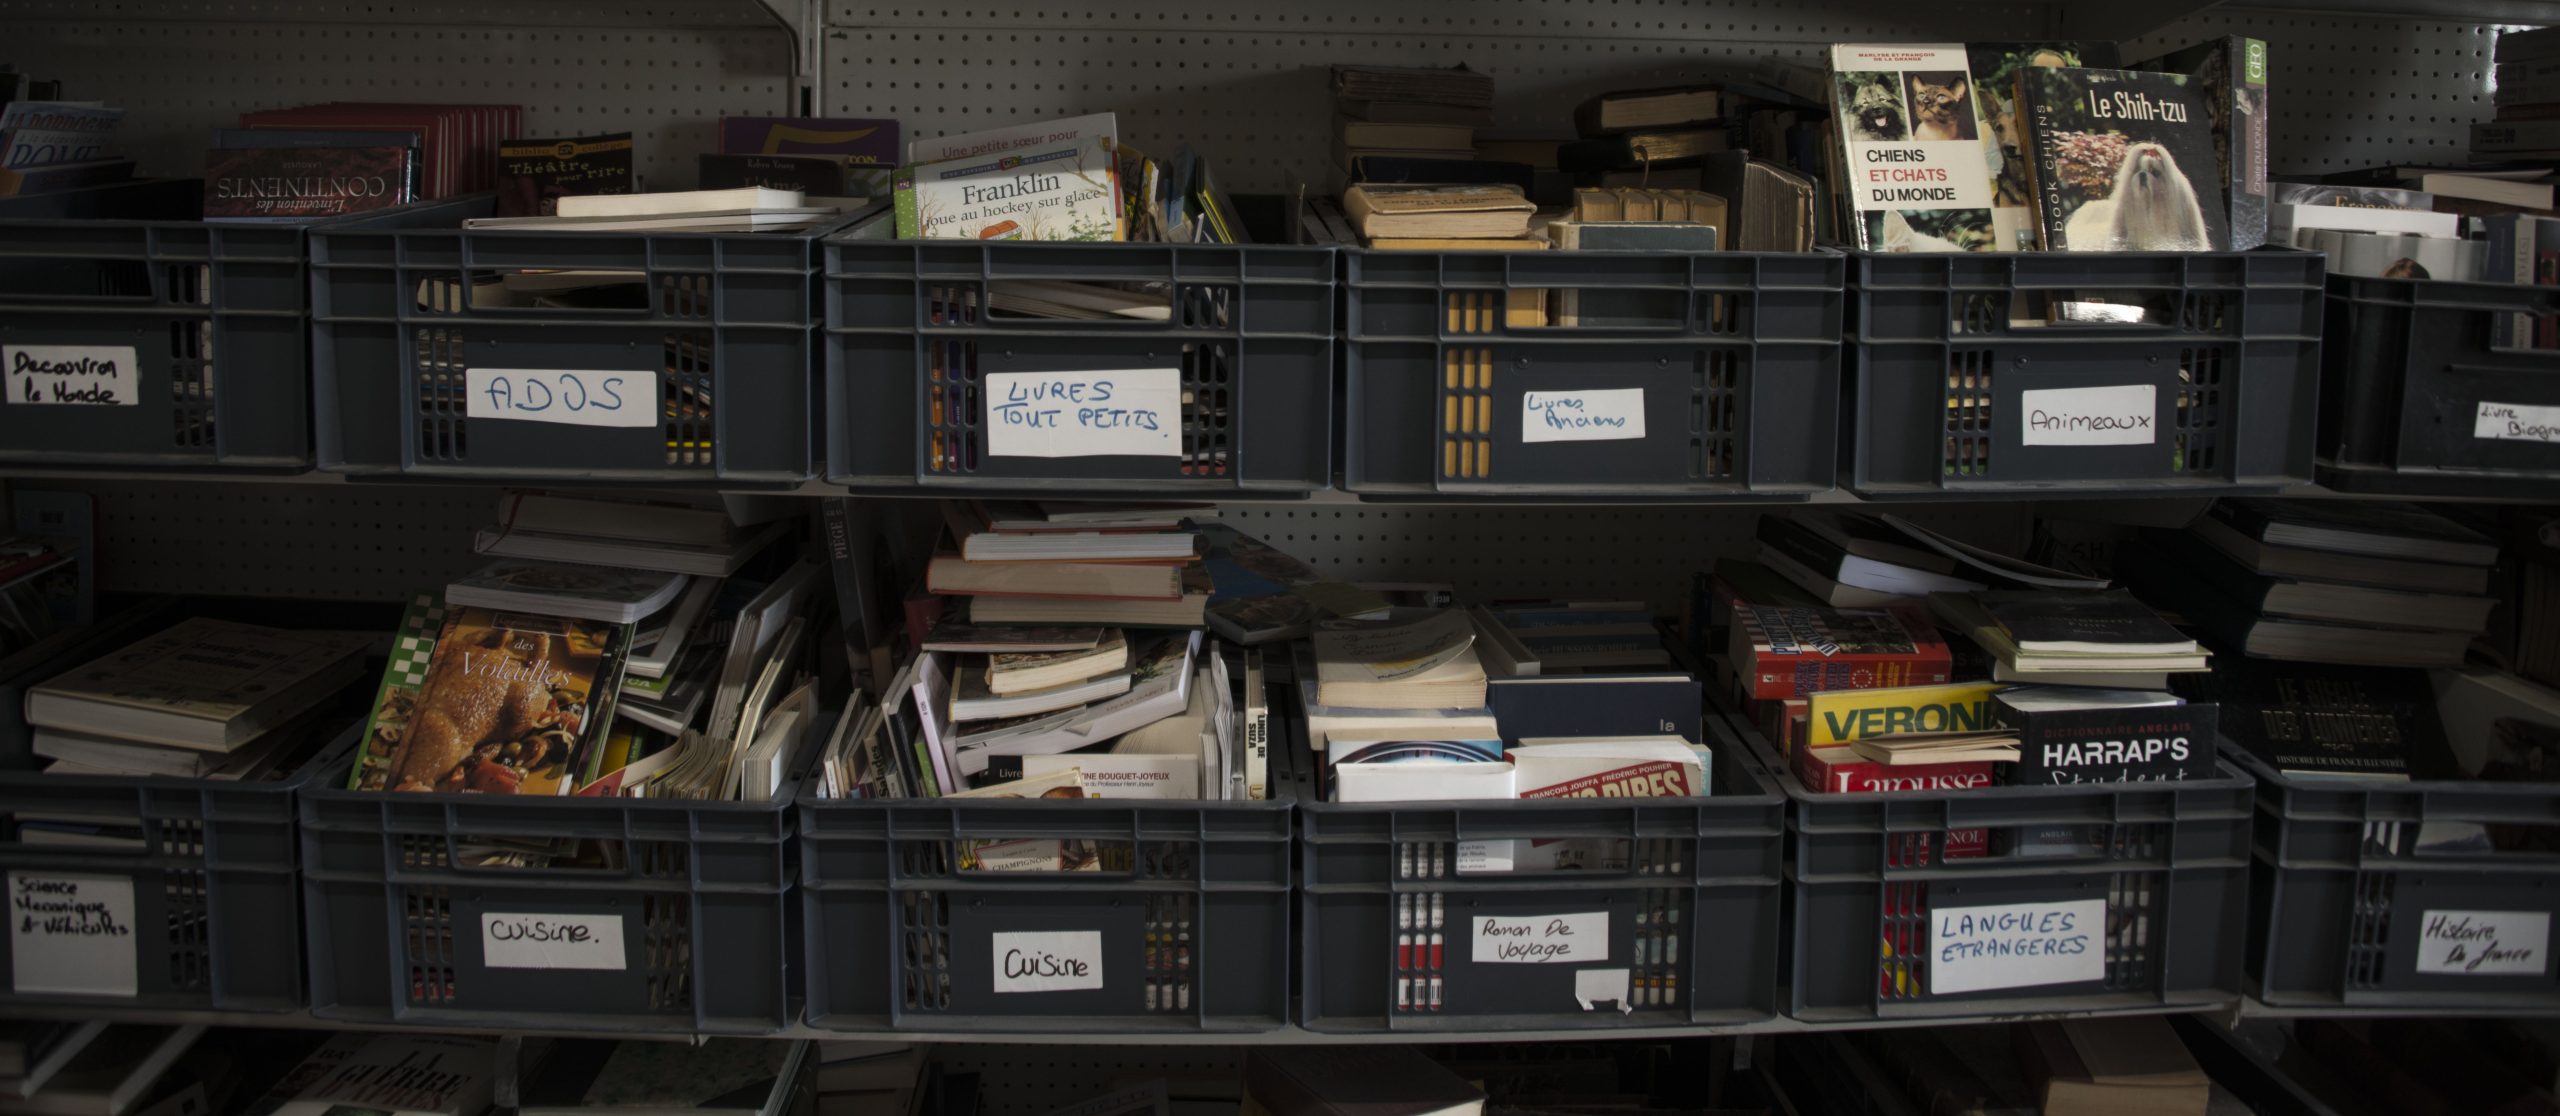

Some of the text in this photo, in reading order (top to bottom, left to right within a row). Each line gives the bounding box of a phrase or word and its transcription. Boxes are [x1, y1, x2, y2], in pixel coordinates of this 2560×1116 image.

[2249, 43, 2263, 79] GEO
[2089, 89, 2189, 124] Le Shih-tzu
[941, 129, 1079, 160] Une petite sœur pour
[2036, 103, 2055, 171] CHIENS
[1866, 149, 1926, 163] CHIENS
[587, 166, 626, 180] rire
[1869, 168, 1948, 183] ET CHATS
[216, 176, 386, 200] CONTINENTS
[961, 172, 1062, 206] Franklin
[1872, 188, 1957, 202] DU MONDE
[255, 198, 345, 213] L'invention des
[925, 189, 1102, 229] joue au hockey sur glace
[2047, 181, 2067, 232] book
[53, 381, 121, 404] Monde
[484, 373, 624, 412] ADOS
[1008, 381, 1114, 404] LIVRES
[993, 402, 1062, 428] TOUT
[1544, 408, 1626, 430] Anciens
[2030, 409, 2152, 432] Animeaux
[513, 638, 536, 651] des
[463, 651, 573, 688] Volailles
[1248, 722, 1257, 749] SUZA
[1256, 714, 1266, 759] LINDA DE
[1658, 717, 1676, 733] la
[2043, 721, 2193, 739] DICTIONNAIRE ANGLAIS
[2042, 736, 2191, 769] HARRAP'S
[2315, 756, 2327, 766] DE
[2328, 757, 2364, 768] FRANCE
[870, 745, 890, 798] Salades
[1098, 772, 1170, 781] BOUGUET-JOYEUX
[1834, 771, 1990, 793] Larousse
[2051, 767, 2189, 787] Student
[1569, 779, 1599, 792] JOUFFA
[992, 855, 1053, 872] CHAMPIGNONS
[1482, 918, 1575, 937] Roman De
[1941, 911, 2076, 938] LANGUES
[2425, 915, 2496, 942] Histoire
[1497, 942, 1572, 963] Voyage
[1941, 935, 2089, 962] ETRANGERES
[1004, 948, 1089, 979] Cuisine
